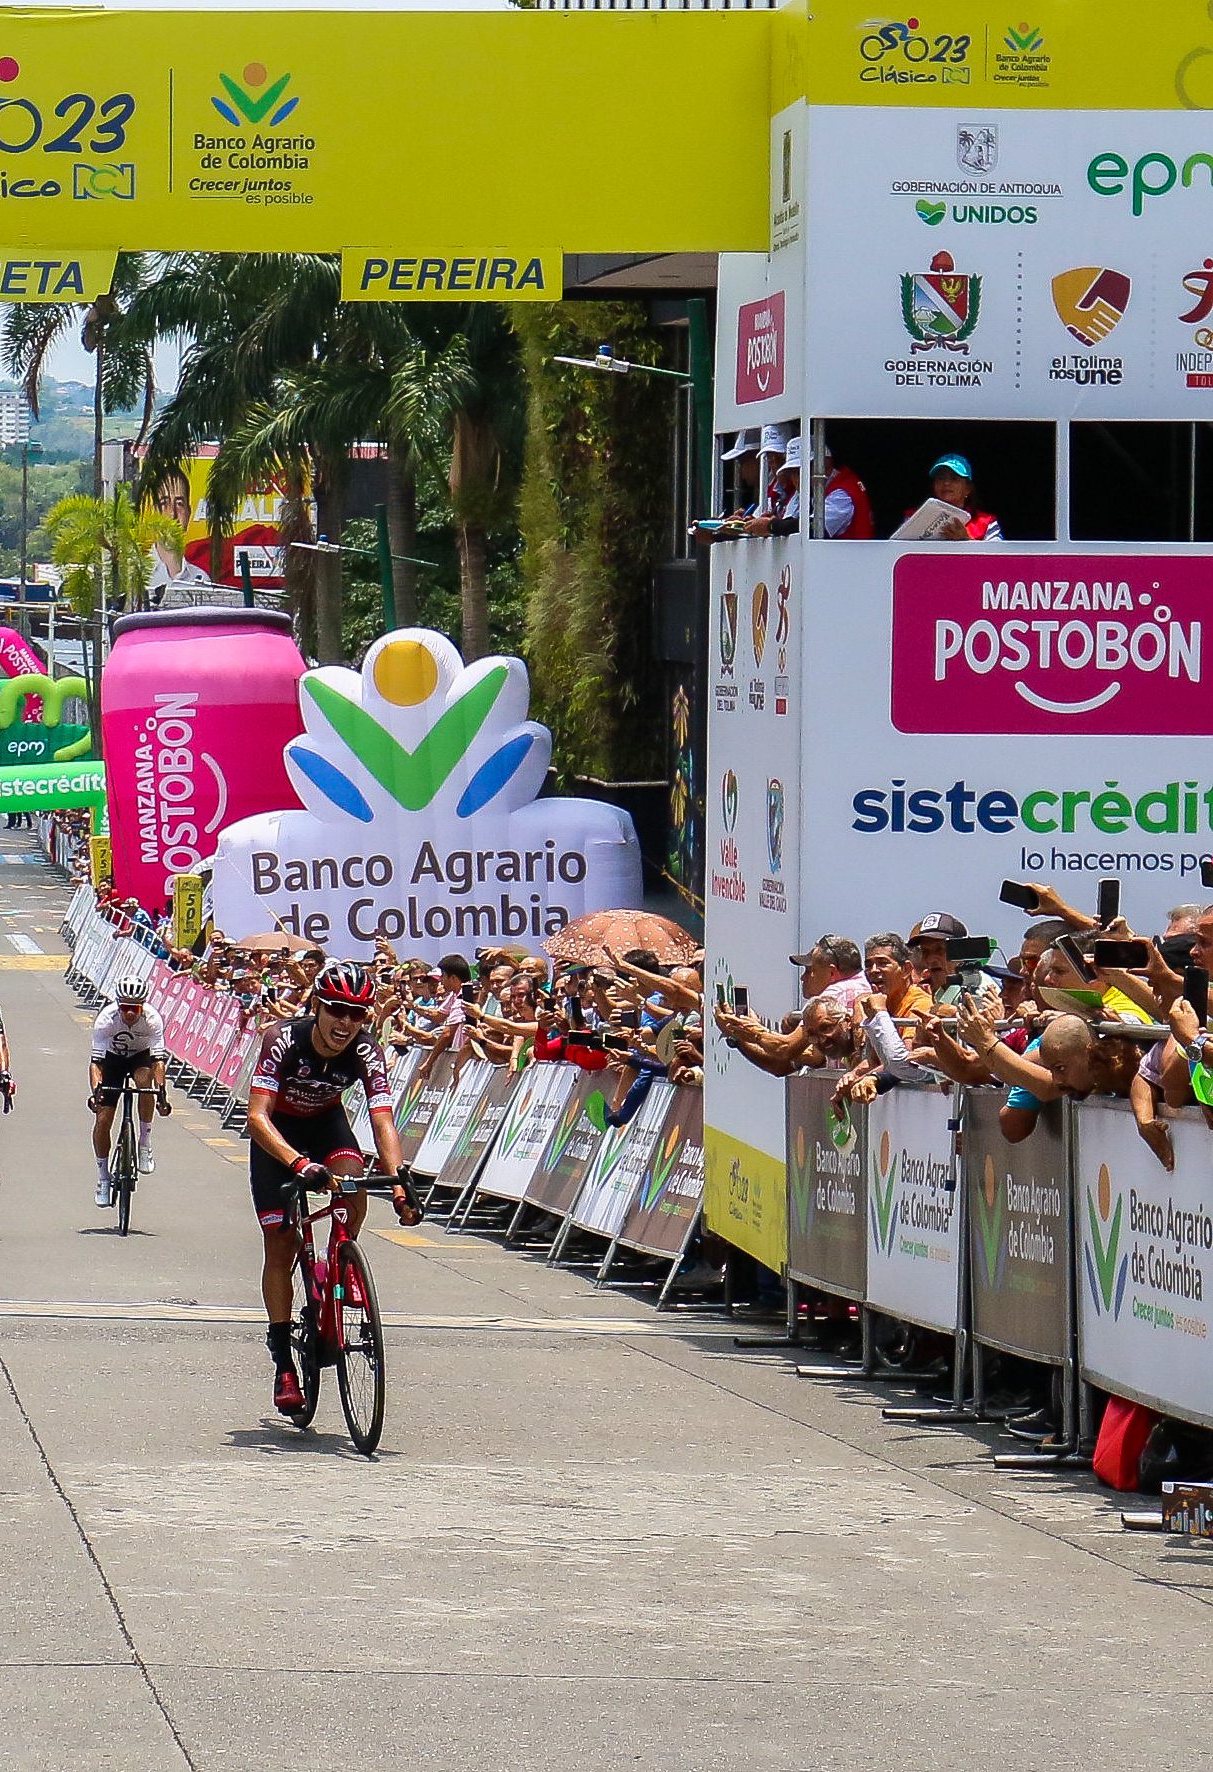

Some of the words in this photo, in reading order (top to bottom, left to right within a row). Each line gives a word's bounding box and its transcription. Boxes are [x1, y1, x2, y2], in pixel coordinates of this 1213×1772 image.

[929, 35, 971, 62] 23
[859, 65, 938, 84] Clásico
[43, 94, 136, 153] 23
[193, 134, 247, 152] Banco
[252, 133, 316, 157] Agrario
[200, 152, 226, 169] de
[228, 151, 309, 171] Colombia
[188, 178, 239, 192] Crecer
[238, 176, 292, 196] juntos
[245, 194, 262, 205] es
[264, 191, 314, 207] posible
[892, 180, 978, 195] GOBERNACIÓN
[980, 182, 997, 195] DE
[999, 182, 1062, 196] ANTIOQUIA
[952, 205, 1038, 225] UNIDOS
[360, 258, 545, 290] PEREIRA
[884, 358, 994, 373] GOBERNACIÓN
[1051, 355, 1067, 369] el
[1071, 355, 1123, 369] Tolima
[1175, 353, 1213, 372] INDEP
[895, 375, 924, 386] DEL
[929, 375, 982, 387] TOLIMA
[1194, 375, 1213, 386] TOL
[982, 581, 1133, 611] MANZANA
[4, 644, 32, 675] POSTO
[7, 741, 45, 758] epm
[135, 744, 159, 863] MANZANA
[851, 779, 1213, 835] sistecrédi
[252, 852, 394, 895] Banco
[410, 840, 587, 894] Agrario
[1021, 847, 1044, 871] lo
[1051, 847, 1174, 871] hacemos
[274, 901, 329, 943] de
[347, 895, 571, 939] Colombia
[816, 1141, 837, 1174] Banco
[901, 1149, 923, 1187] Banco
[925, 1153, 949, 1197] Agrar
[900, 1192, 910, 1225] de
[910, 1193, 950, 1234] Colombia
[1007, 1174, 1032, 1214] Banco
[1031, 1177, 1061, 1226] Agrario
[1130, 1189, 1164, 1235] Banco
[1166, 1198, 1213, 1252] Agrario
[1008, 1222, 1026, 1256] de
[1026, 1219, 1056, 1265] Colombia
[1131, 1239, 1147, 1285] de
[1148, 1244, 1203, 1302] Colombia
